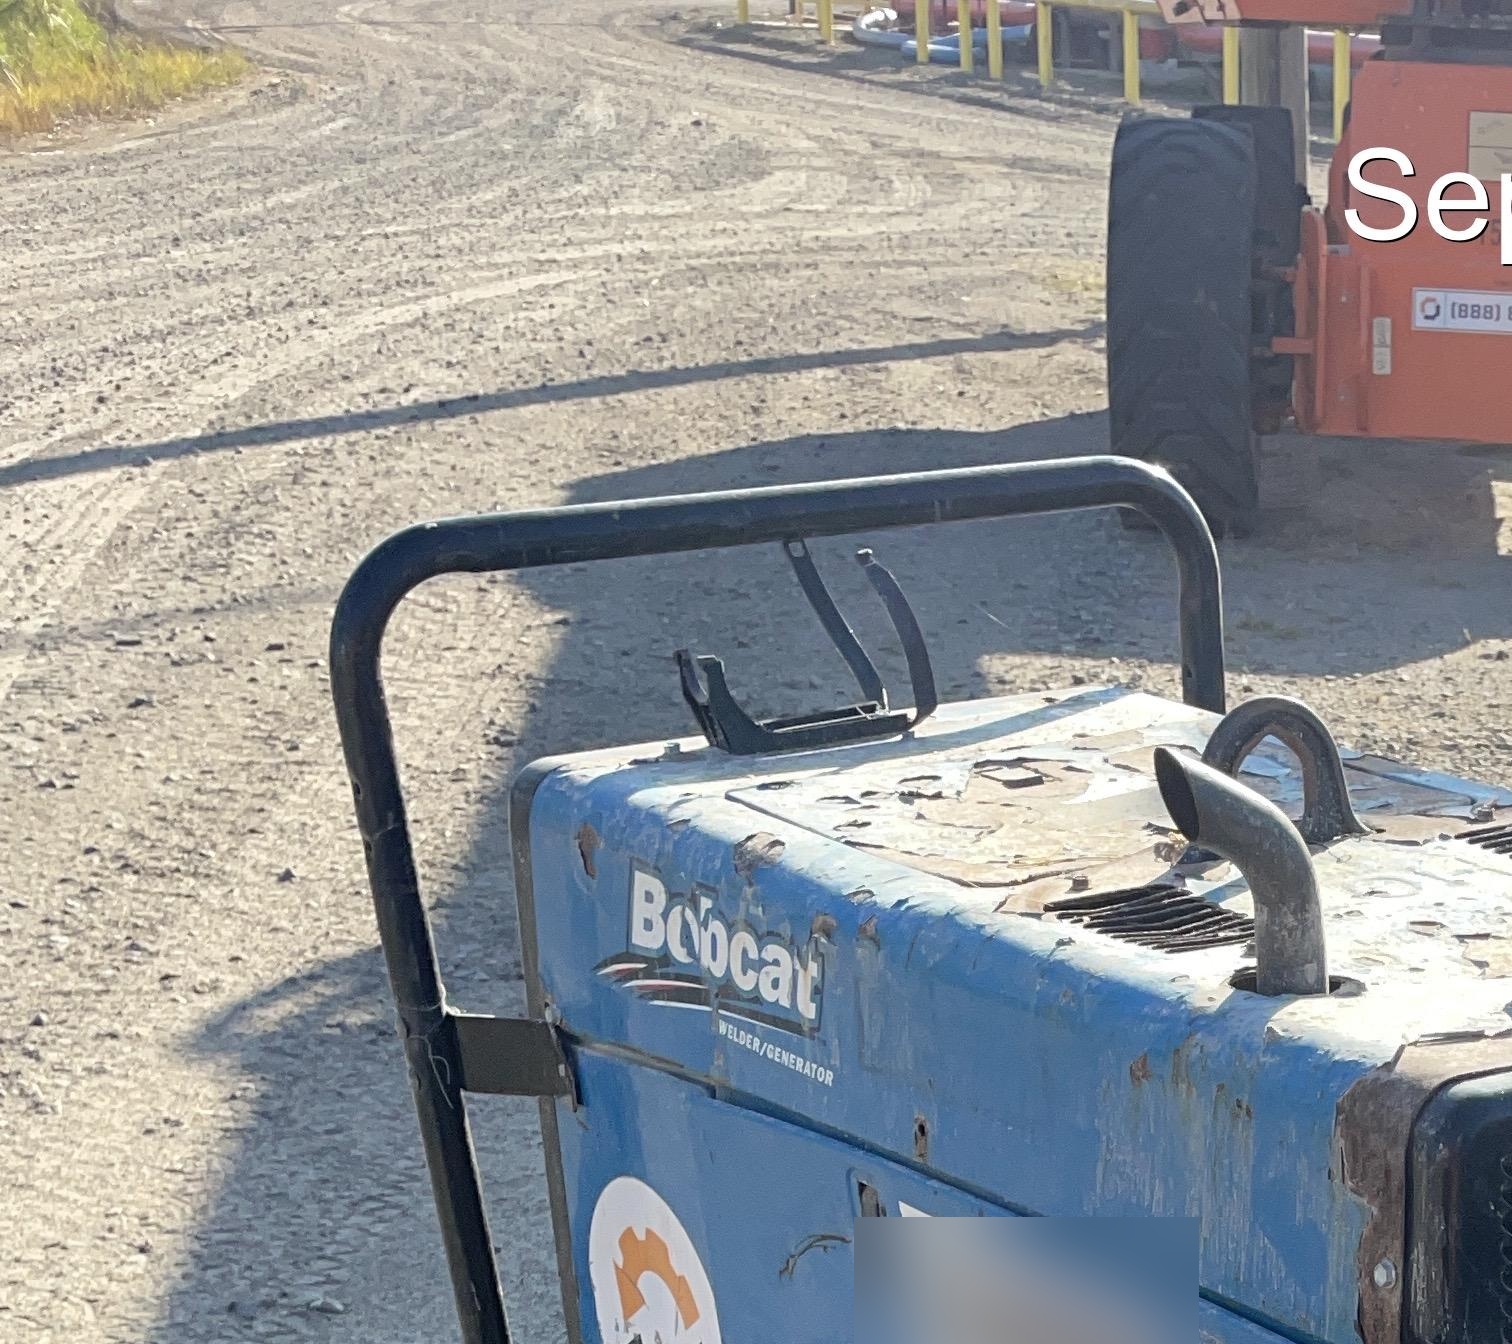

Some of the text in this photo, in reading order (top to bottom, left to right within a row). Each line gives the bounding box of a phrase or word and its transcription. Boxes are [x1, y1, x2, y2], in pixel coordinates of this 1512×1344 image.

[1450, 301, 1500, 323] (888)
[631, 869, 819, 1020] Bobcat
[718, 1018, 834, 1087] WELDER/GENERATOR
